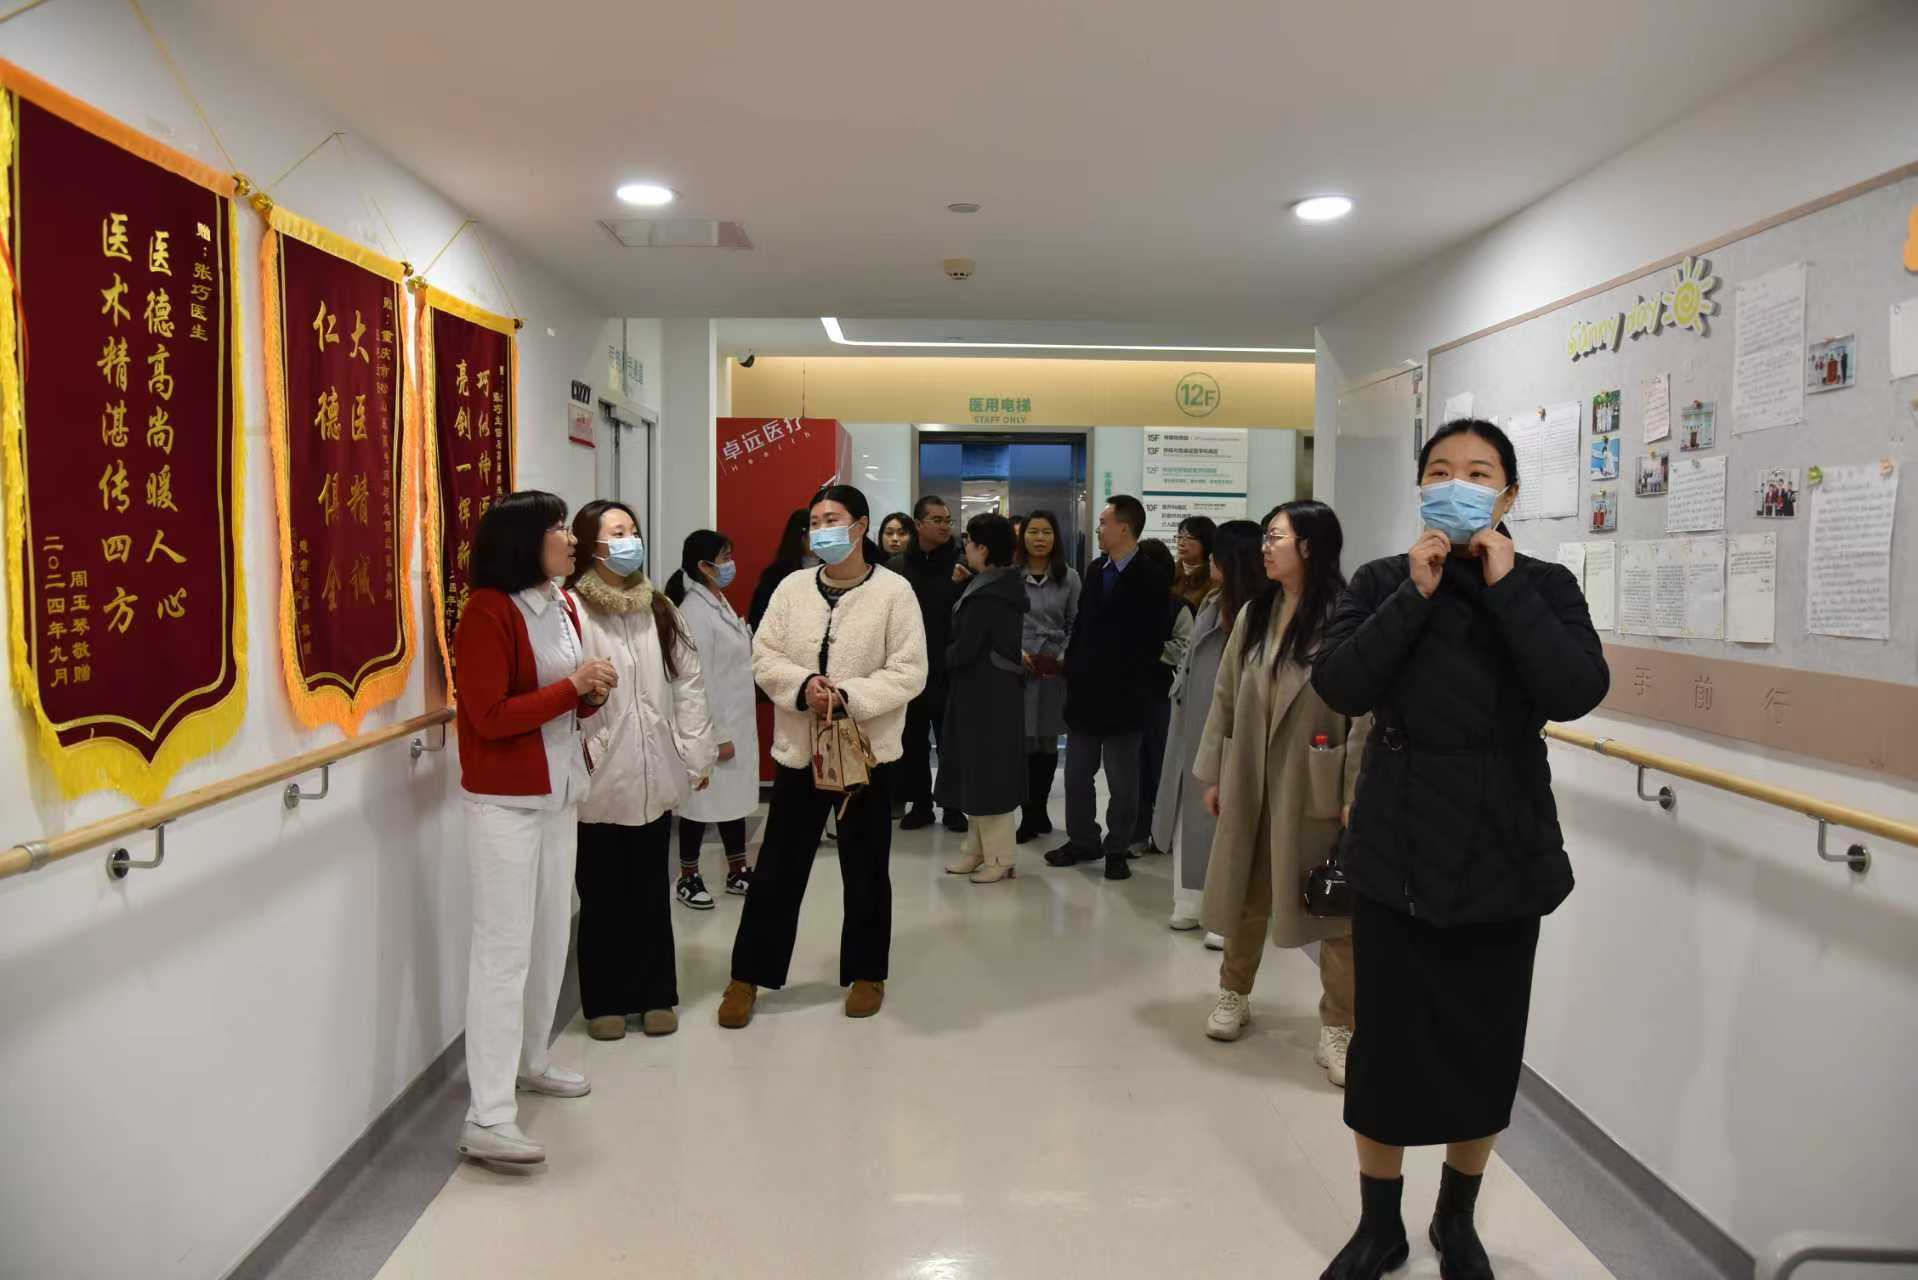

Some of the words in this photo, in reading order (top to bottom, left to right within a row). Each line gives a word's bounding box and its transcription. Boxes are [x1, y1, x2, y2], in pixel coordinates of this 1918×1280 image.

[1567, 312, 1624, 361] Sunny
[1625, 292, 1665, 338] day
[968, 397, 1032, 413] 医用电梯
[1180, 384, 1217, 407] 12F
[97, 212, 139, 634] 医术精湛传四方
[144, 230, 188, 620] 医德高尚暖人心
[973, 416, 1000, 425] STAFF
[1002, 416, 1027, 425] ONLY
